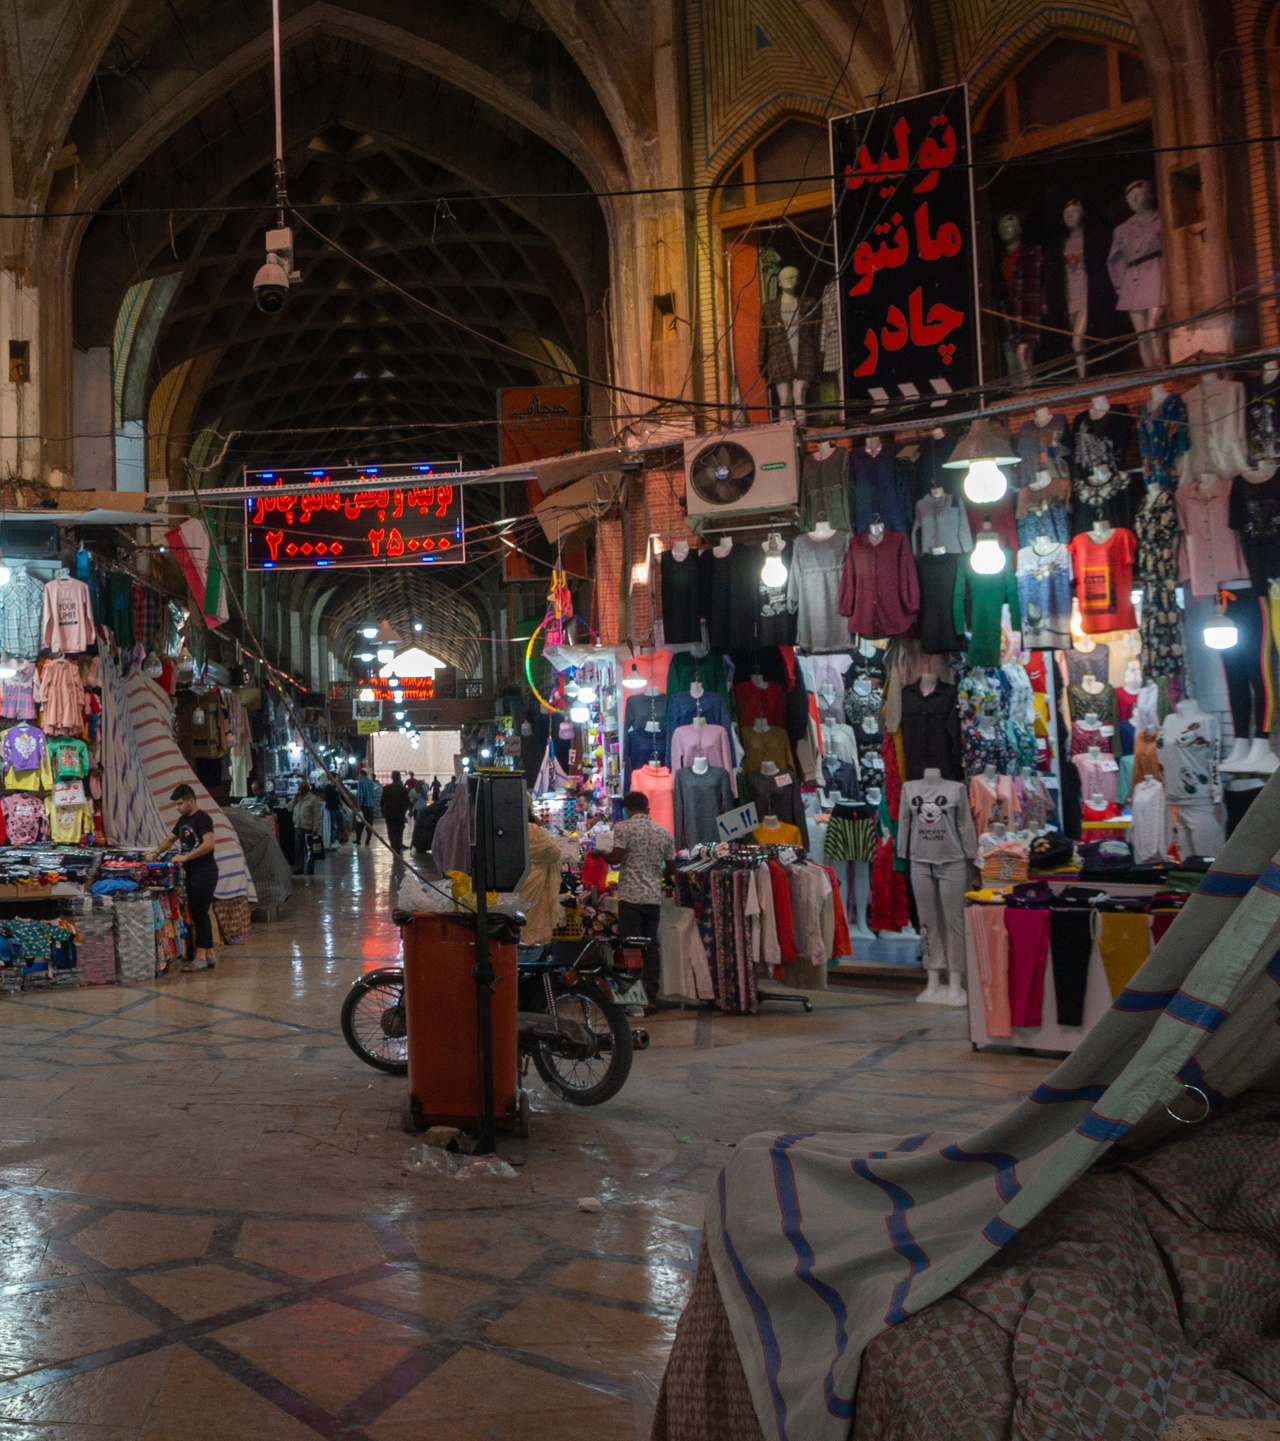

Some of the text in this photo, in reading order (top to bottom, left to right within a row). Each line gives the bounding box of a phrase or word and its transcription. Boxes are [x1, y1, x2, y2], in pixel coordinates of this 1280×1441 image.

[845, 114, 957, 197] تولید
[848, 201, 961, 297] مانتو
[854, 286, 964, 378] چادر
[508, 395, 570, 420] حجاب
[60, 794, 76, 804] خرید
